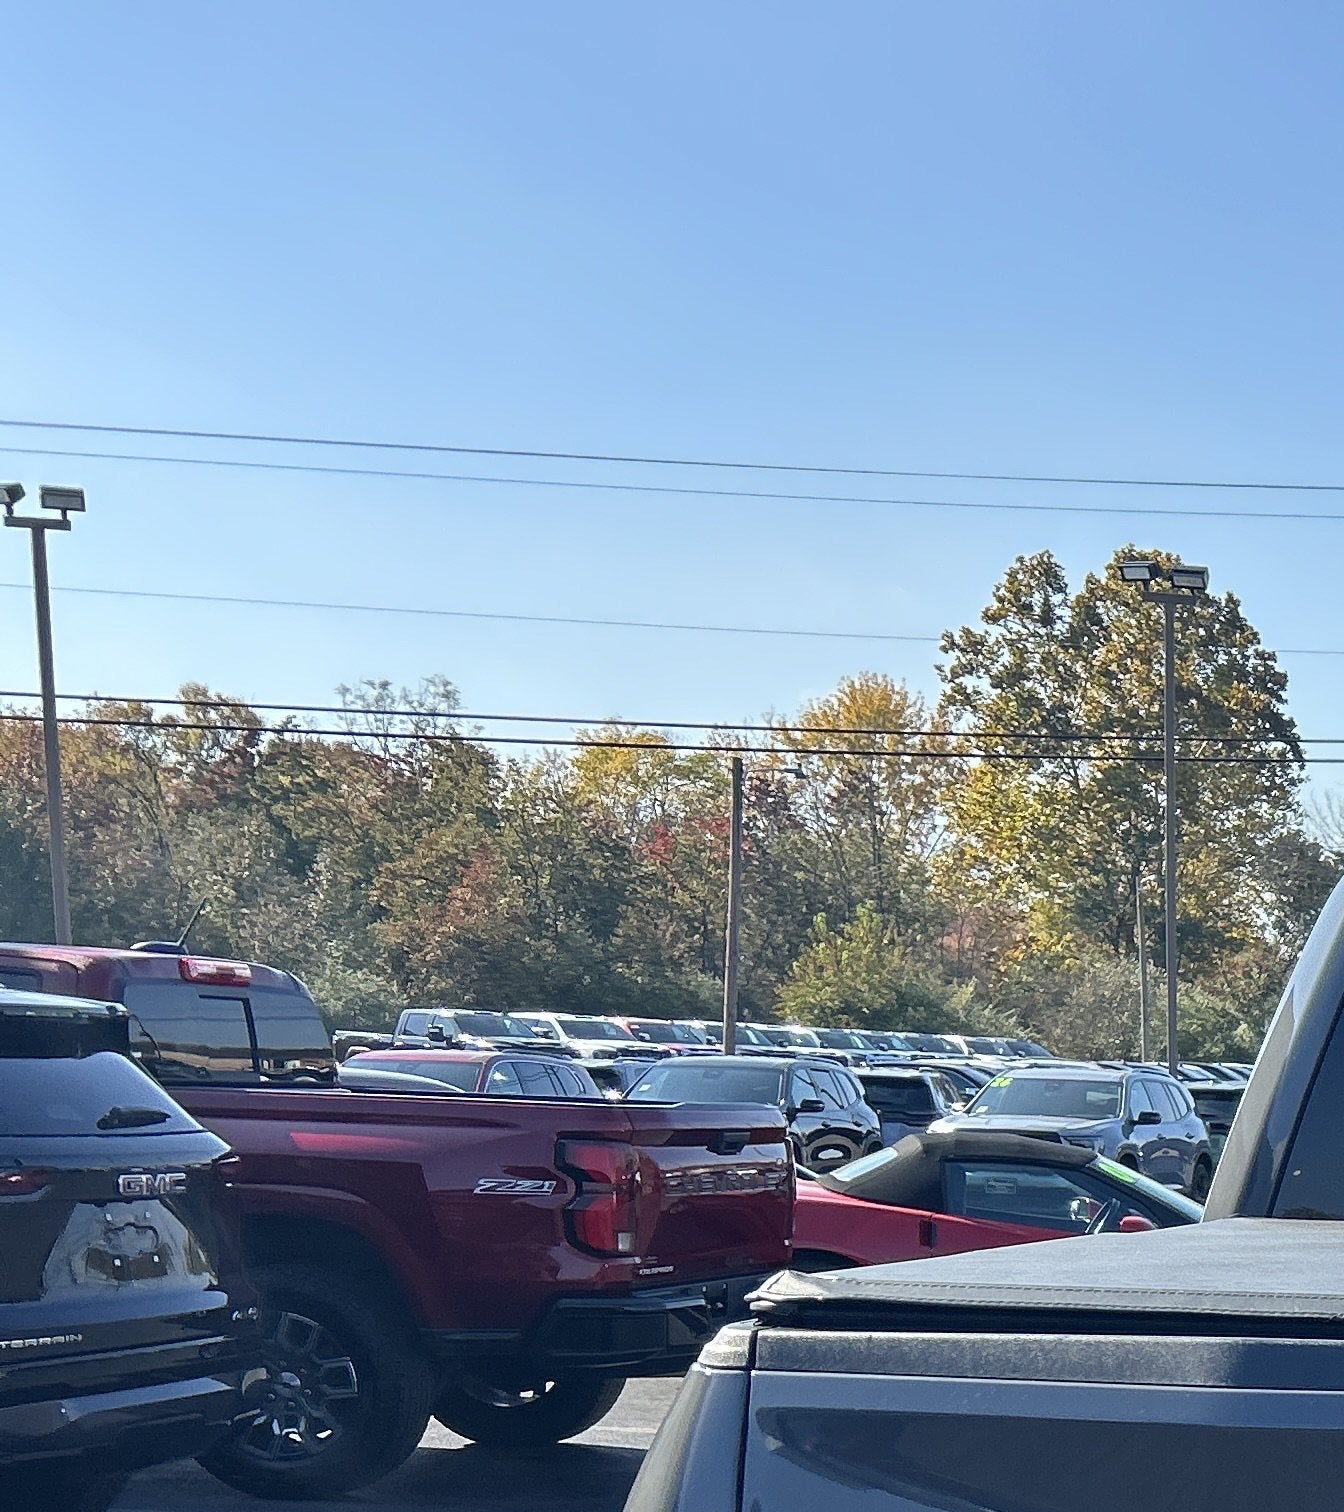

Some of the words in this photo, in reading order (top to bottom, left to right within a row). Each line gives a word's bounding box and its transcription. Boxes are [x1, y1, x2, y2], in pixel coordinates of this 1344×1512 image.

[118, 1172, 188, 1197] GMC
[473, 1178, 557, 1196] Z71
[0, 1333, 83, 1351] TERRAIN
